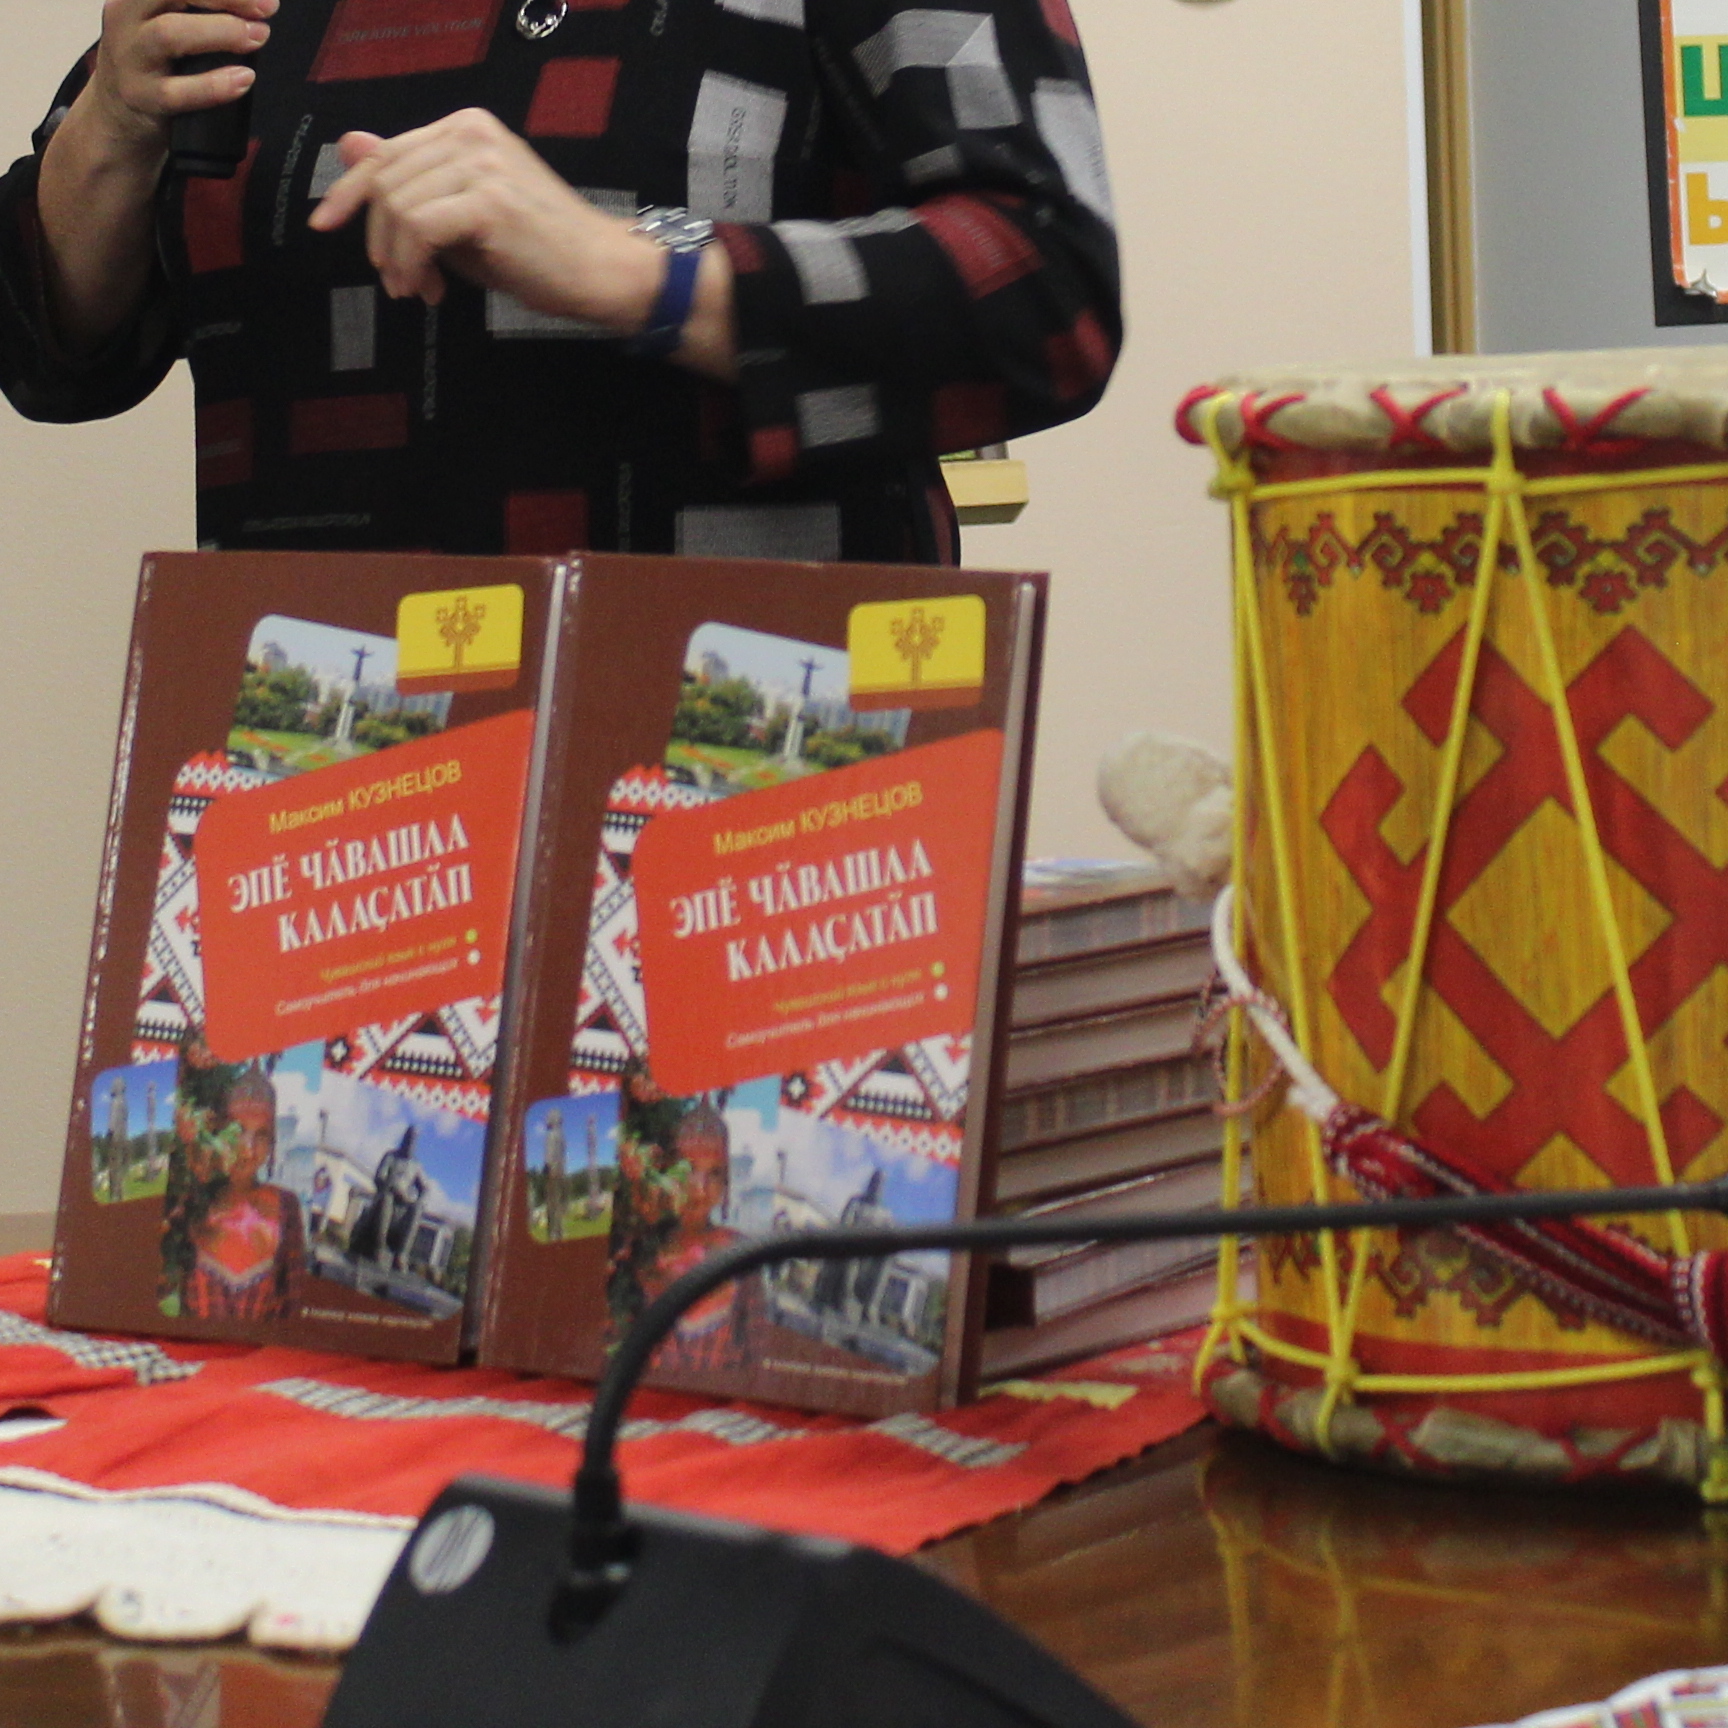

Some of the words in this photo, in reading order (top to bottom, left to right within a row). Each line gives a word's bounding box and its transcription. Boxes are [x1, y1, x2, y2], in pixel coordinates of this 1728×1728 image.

[269, 799, 345, 834] Максим
[348, 759, 462, 812] КУЗНЕЦОВ
[713, 820, 796, 855] Максим
[799, 780, 924, 833] КУЗНЕЦОВ
